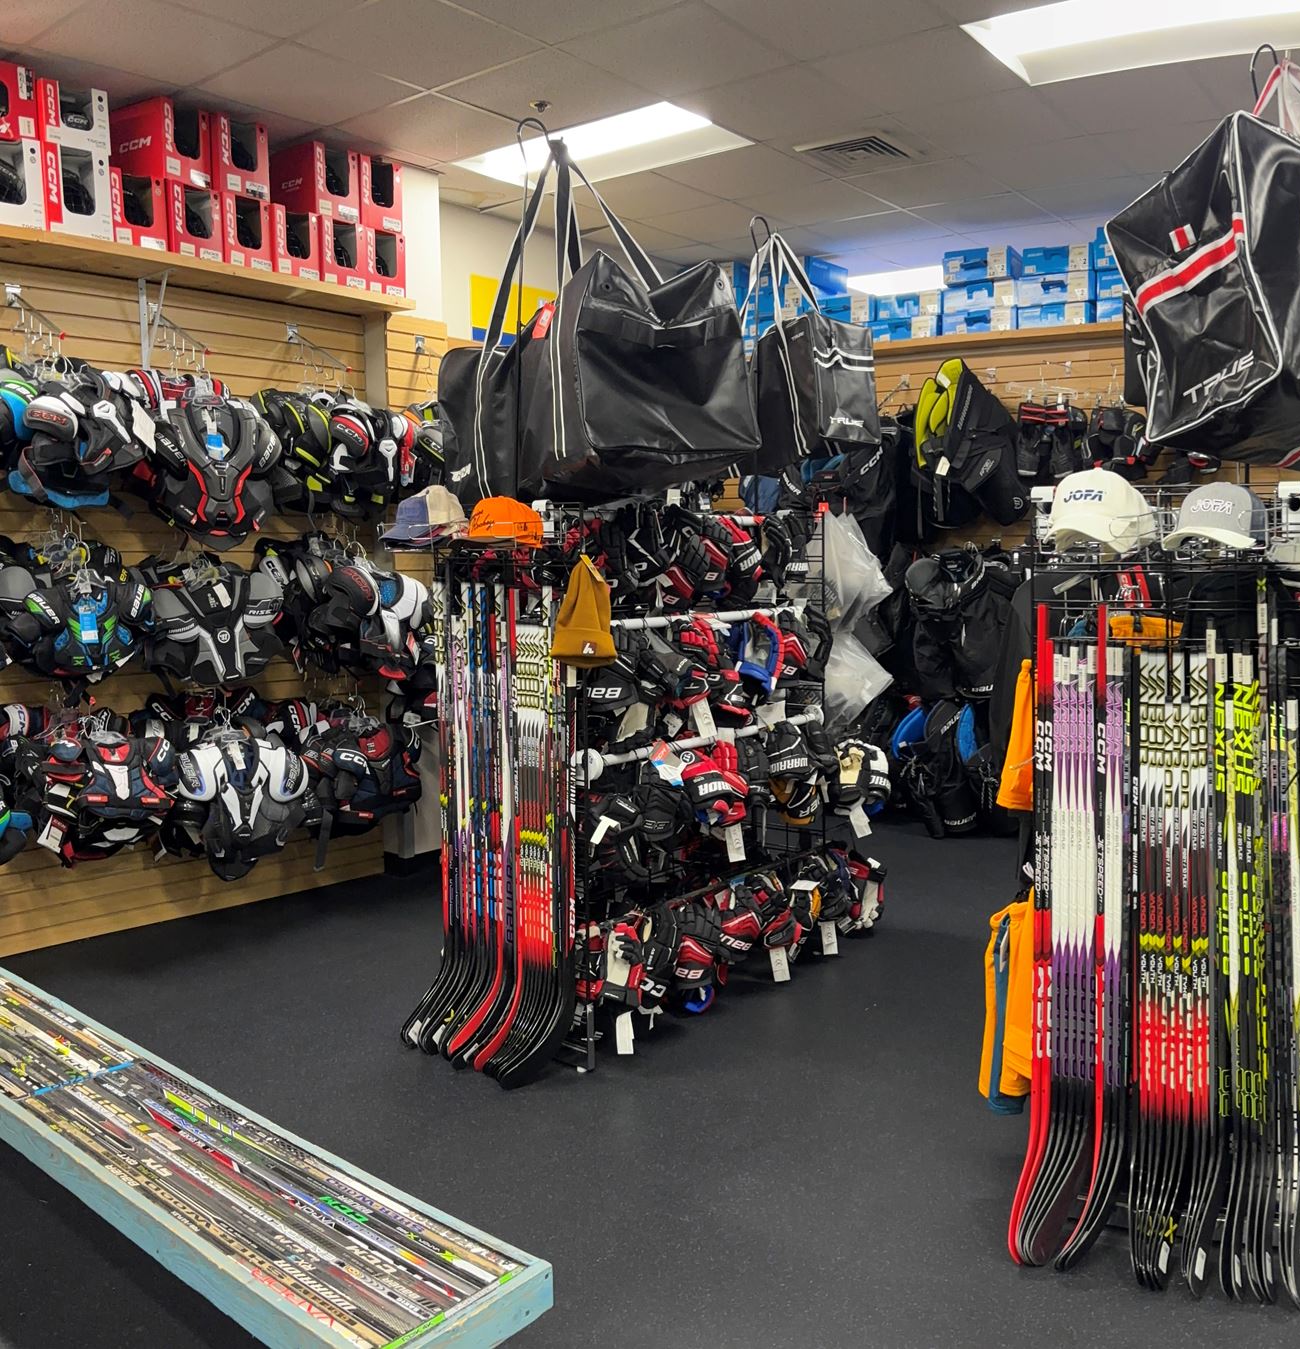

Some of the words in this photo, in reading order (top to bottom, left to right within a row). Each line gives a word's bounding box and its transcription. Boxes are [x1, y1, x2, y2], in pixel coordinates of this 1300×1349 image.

[46, 84, 59, 126] CCM
[164, 102, 174, 152] CCM
[119, 136, 152, 154] CCM
[220, 116, 229, 166] CCM
[46, 151, 58, 204] CCM
[316, 147, 324, 192] CCM
[362, 161, 370, 205] CCM
[110, 172, 122, 224] CCM
[174, 184, 184, 234] CCM
[226, 198, 235, 246] CCM
[276, 210, 285, 256] CCM
[324, 220, 332, 264] CCM
[1183, 350, 1254, 404] TRUE
[336, 422, 364, 446] CCM
[830, 416, 864, 428] TRUE
[1063, 489, 1105, 504] JOFA
[1190, 498, 1233, 515] JOFA
[27, 592, 61, 625] BAUER
[152, 702, 173, 722] CC
[1278, 701, 1286, 751] TRUE
[156, 738, 170, 762] CC
[1036, 720, 1045, 772] CCM
[1044, 720, 1053, 772] CCM
[1097, 722, 1106, 774] CCM
[1216, 682, 1226, 793] NEXUS
[1234, 684, 1244, 794] NEXUS
[1242, 686, 1254, 796] NEXUS
[768, 756, 808, 773] WARRIO
[504, 864, 514, 944] BAUER
[640, 977, 667, 998] CC
[105, 1164, 140, 1187] BAUER
[294, 1200, 336, 1229] VAPOR
[319, 1194, 369, 1224] CCM
[346, 1245, 398, 1275] CCM
[250, 1266, 336, 1328] VAPOR
[274, 1259, 358, 1313] WARRIOR
[382, 1276, 422, 1306] BAUER
